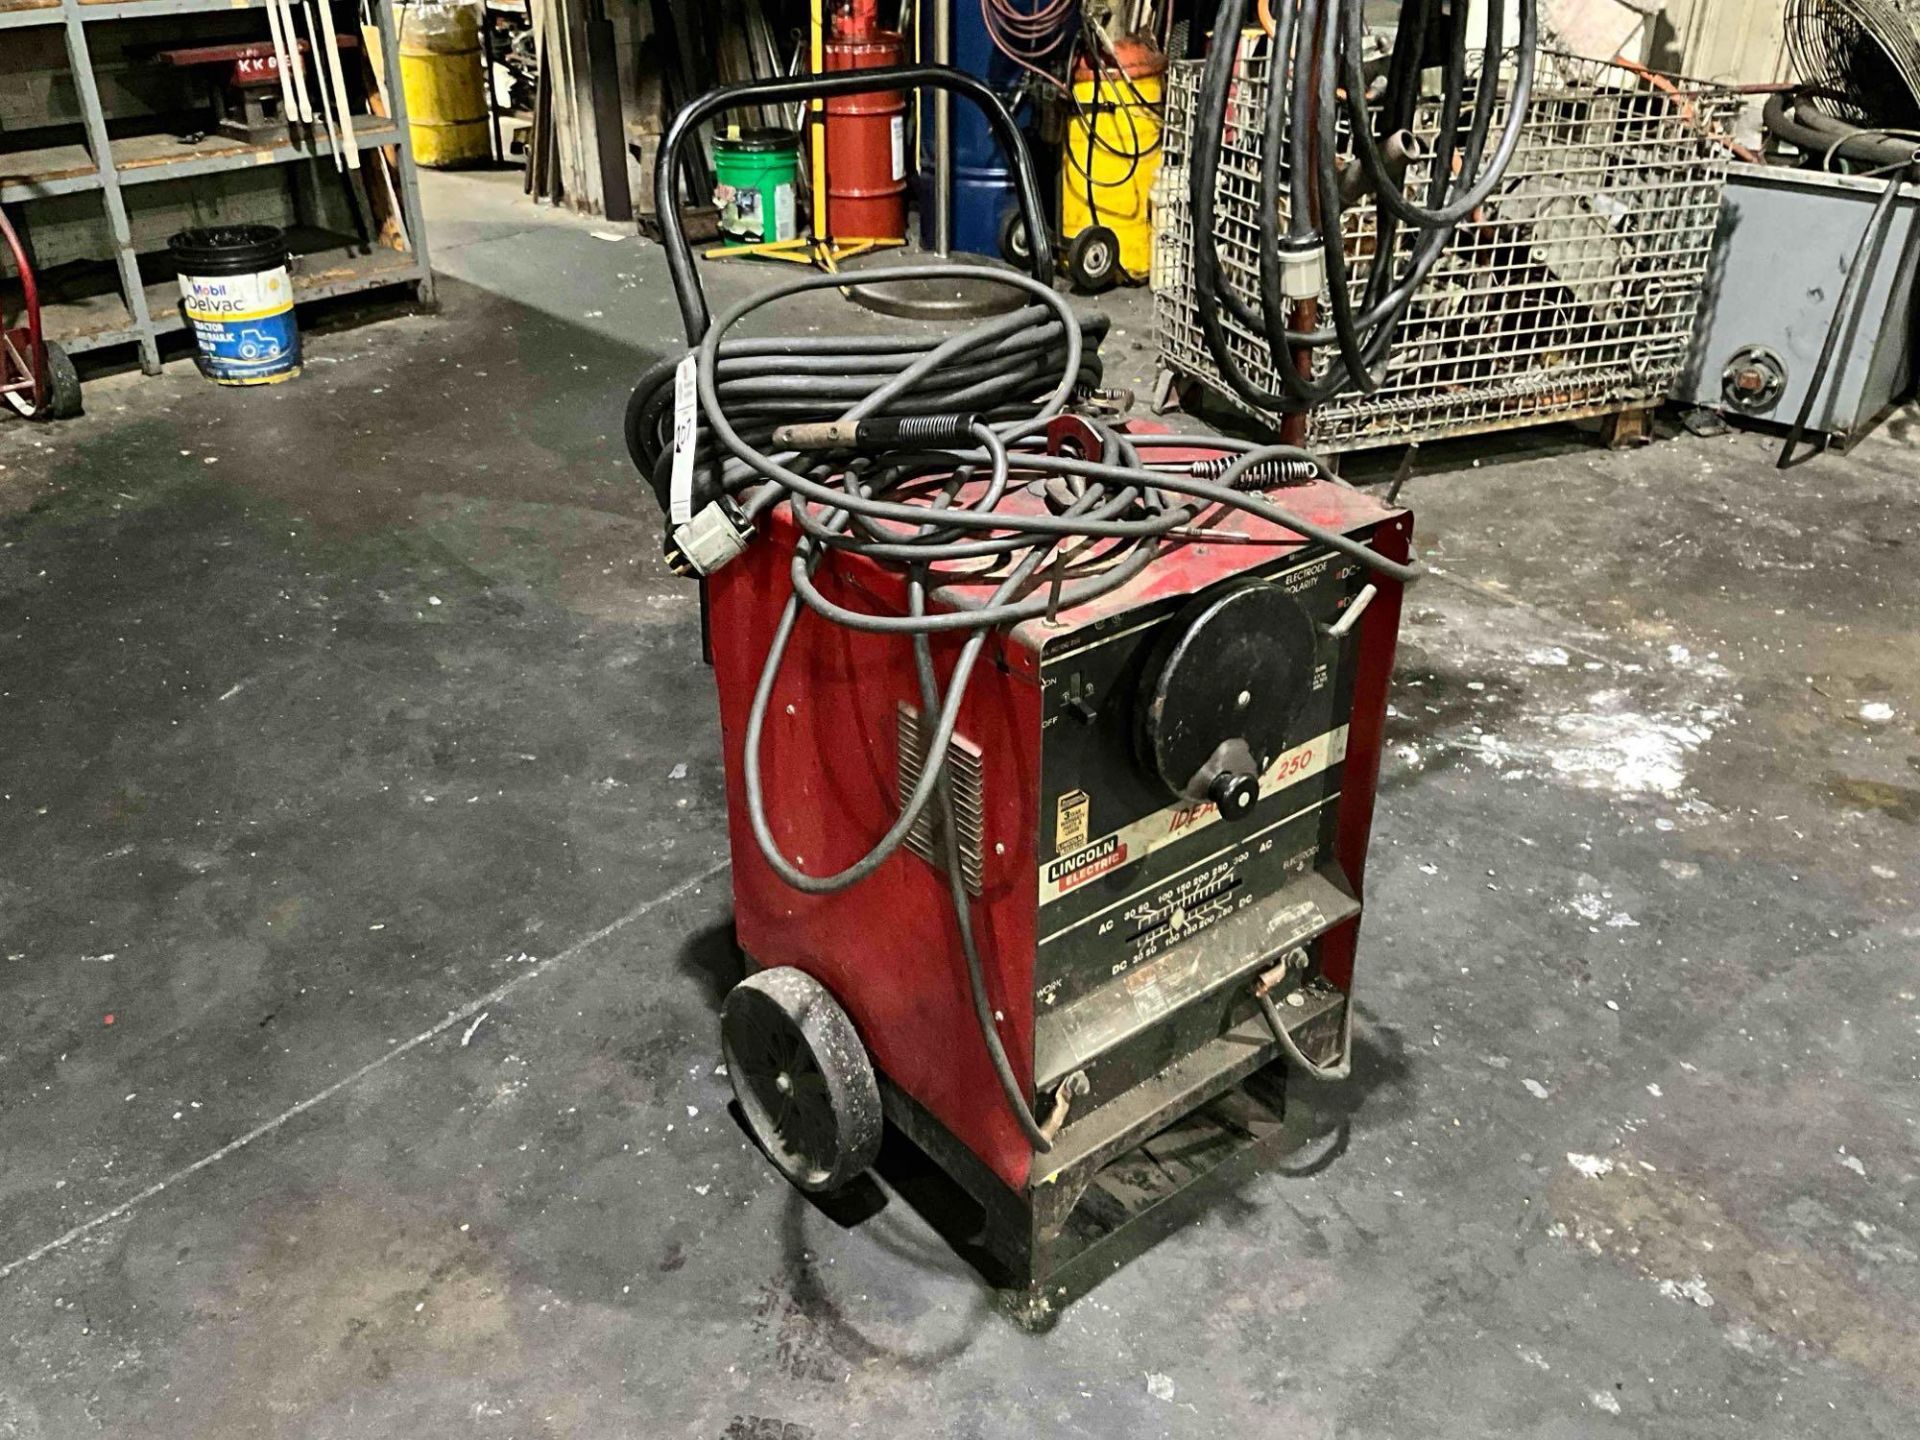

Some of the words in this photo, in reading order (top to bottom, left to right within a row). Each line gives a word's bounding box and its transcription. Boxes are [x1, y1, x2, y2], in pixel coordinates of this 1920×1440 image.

[187, 295, 245, 312] Delvac
[193, 285, 226, 296] Mobil
[1285, 562, 1328, 585] ELECTRODE
[1042, 716, 1059, 728] OFF
[1277, 750, 1312, 781] 250
[1168, 801, 1217, 833] IDEA
[1052, 840, 1115, 879] LINCOLN
[1065, 853, 1120, 886] ELECTRIC
[1098, 920, 1114, 935] AC
[1158, 890, 1173, 903] 100
[1259, 840, 1272, 853] AC
[1112, 960, 1127, 975] DC
[1165, 933, 1180, 946] 100
[1239, 894, 1252, 908] DC
[1036, 978, 1063, 998] WORK
